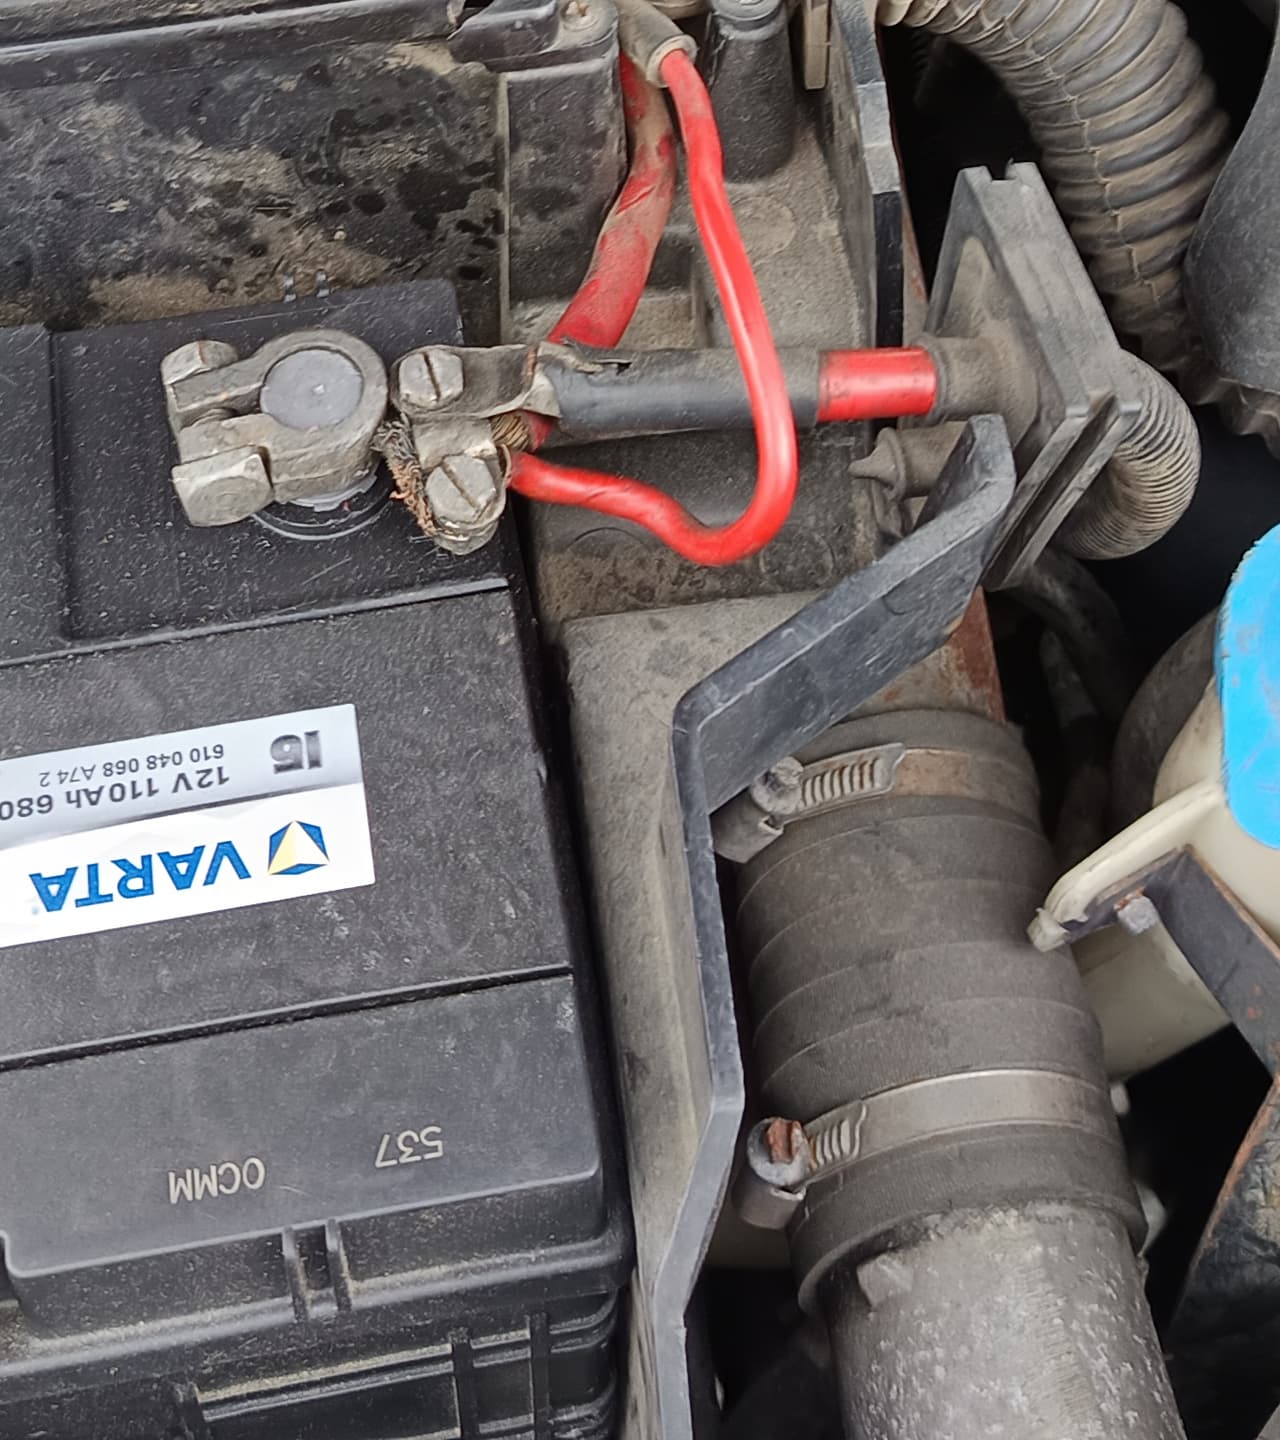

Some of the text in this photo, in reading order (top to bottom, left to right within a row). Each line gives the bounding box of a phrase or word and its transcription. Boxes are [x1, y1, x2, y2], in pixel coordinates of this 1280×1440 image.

[38, 743, 225, 787] 610 048 068 A74 2
[171, 765, 231, 794] 12V
[65, 775, 160, 809] 110Ah
[28, 840, 253, 913] VARTA
[374, 1125, 444, 1169] 537
